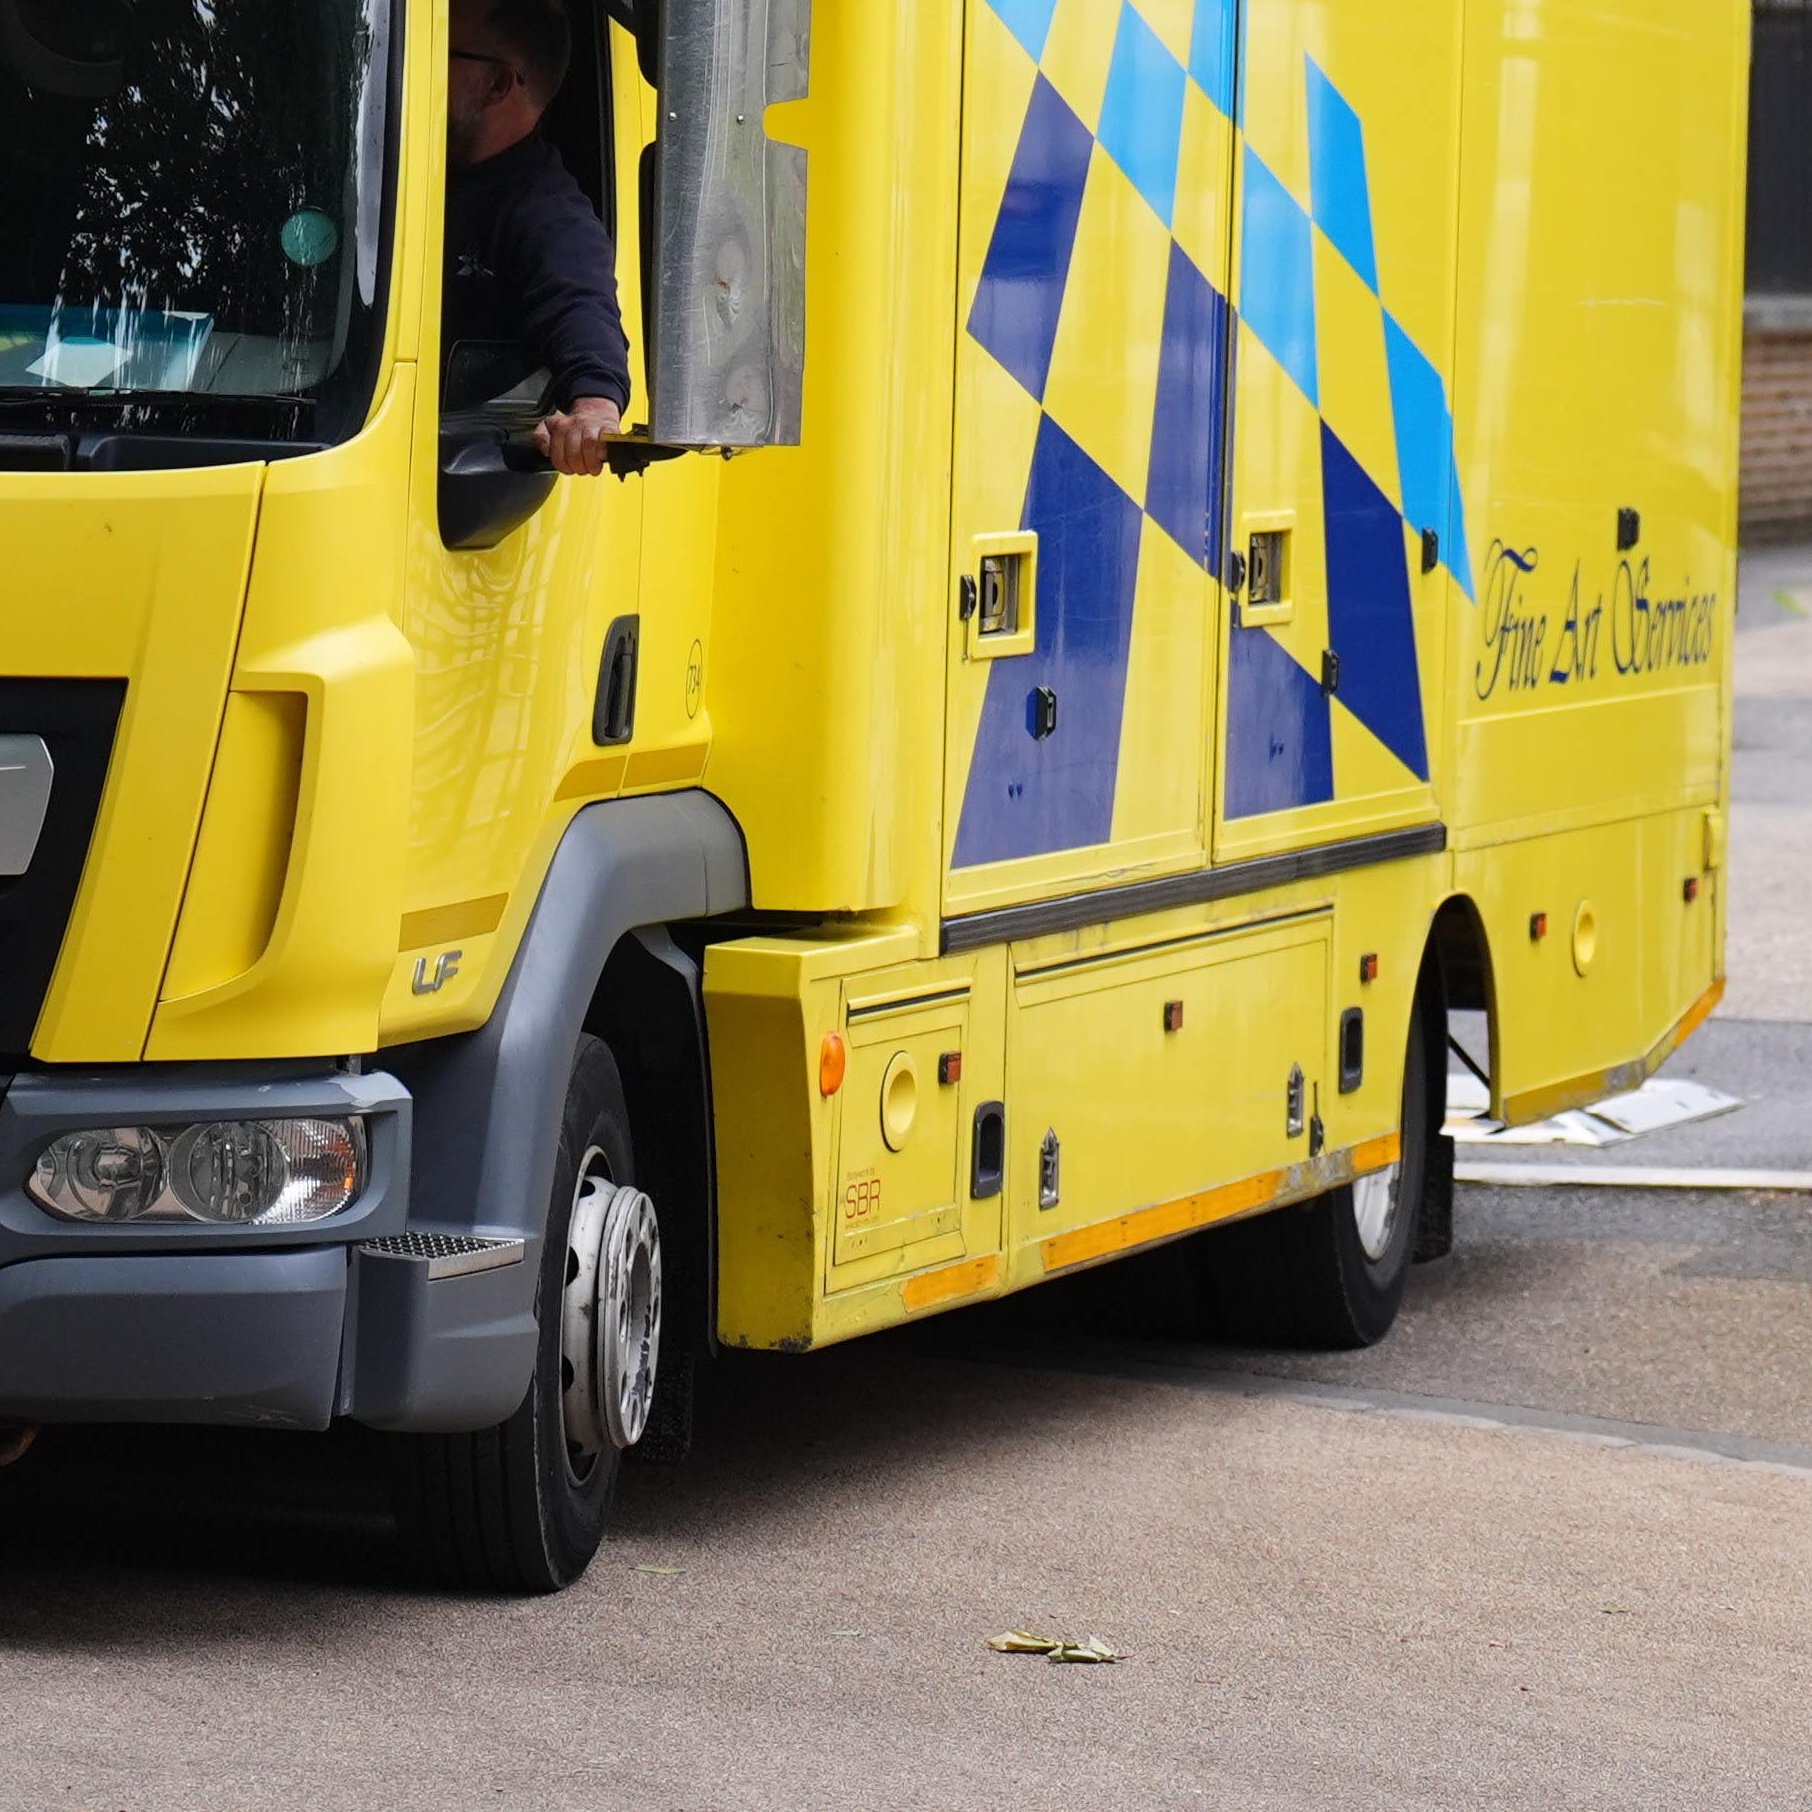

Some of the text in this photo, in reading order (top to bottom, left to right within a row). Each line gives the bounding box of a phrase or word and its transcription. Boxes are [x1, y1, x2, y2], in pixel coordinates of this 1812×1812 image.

[1475, 538, 1716, 700] Fine Art Services
[412, 950, 462, 995] LF
[844, 1179, 880, 1219] SBR
